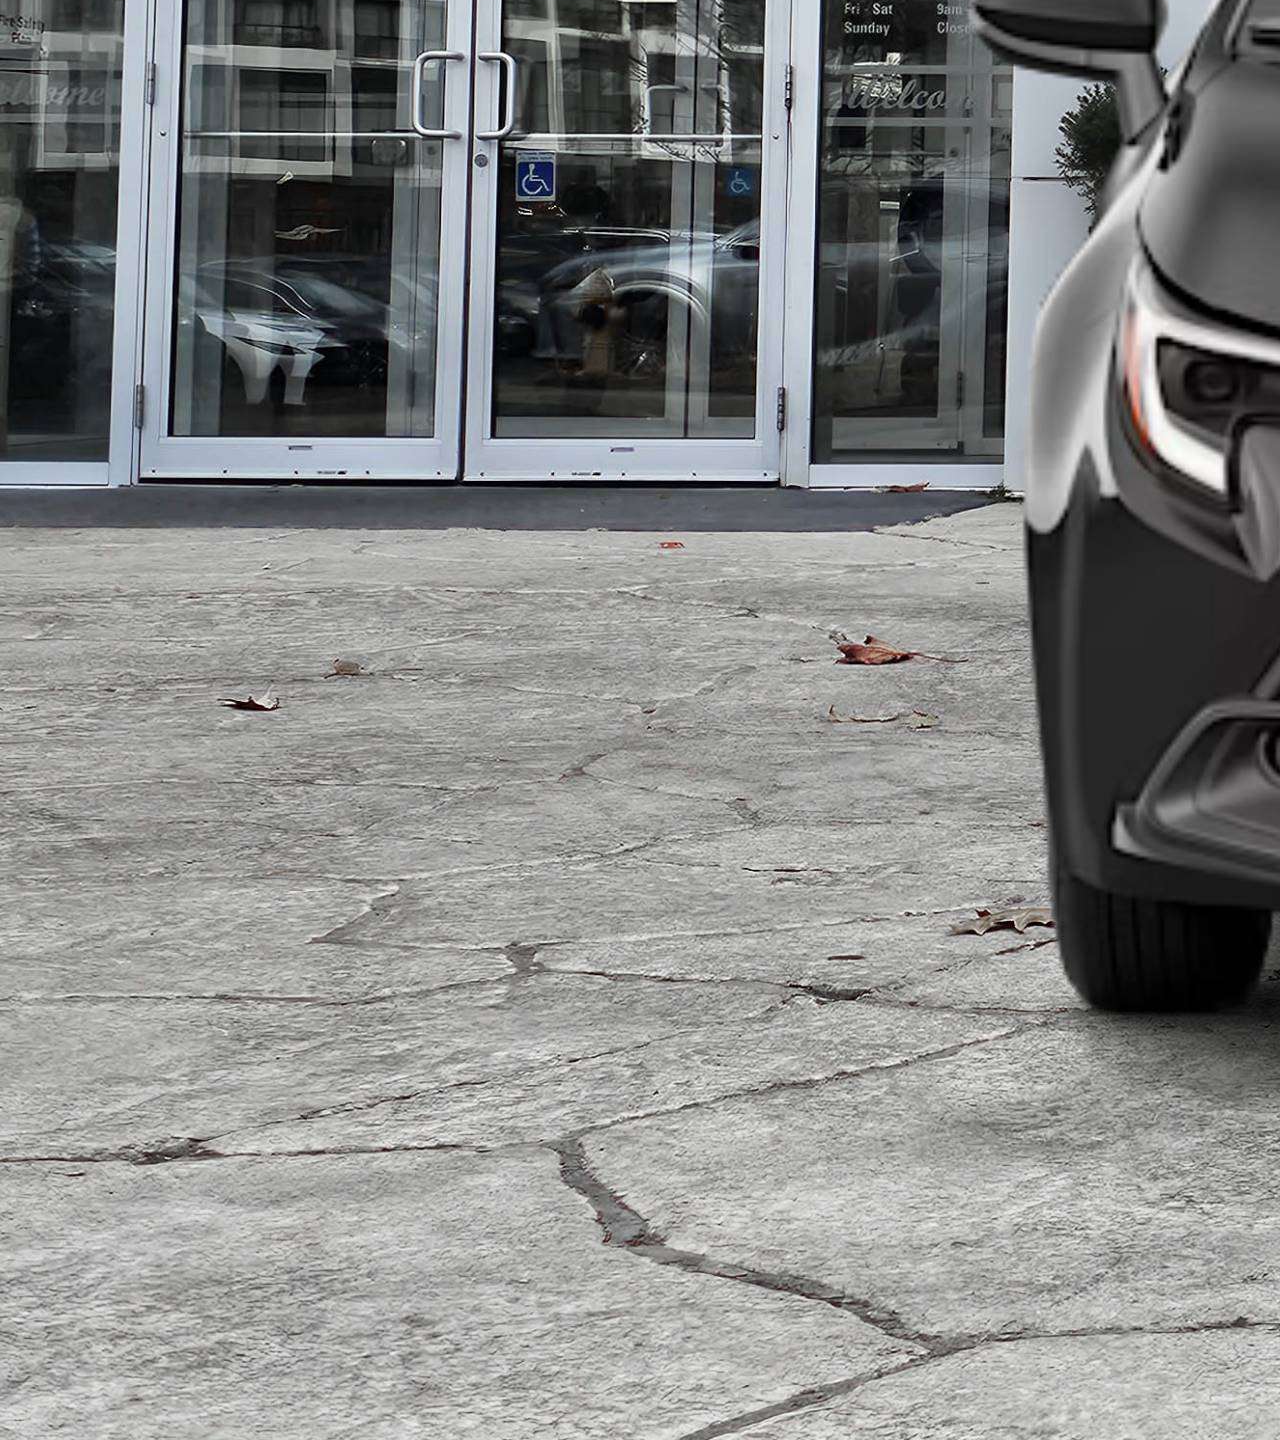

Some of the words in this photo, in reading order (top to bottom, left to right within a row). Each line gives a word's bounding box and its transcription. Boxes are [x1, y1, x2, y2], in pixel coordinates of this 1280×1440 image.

[844, 3, 860, 15] Fri
[872, 2, 894, 15] Sat
[844, 22, 891, 36] Sunday
